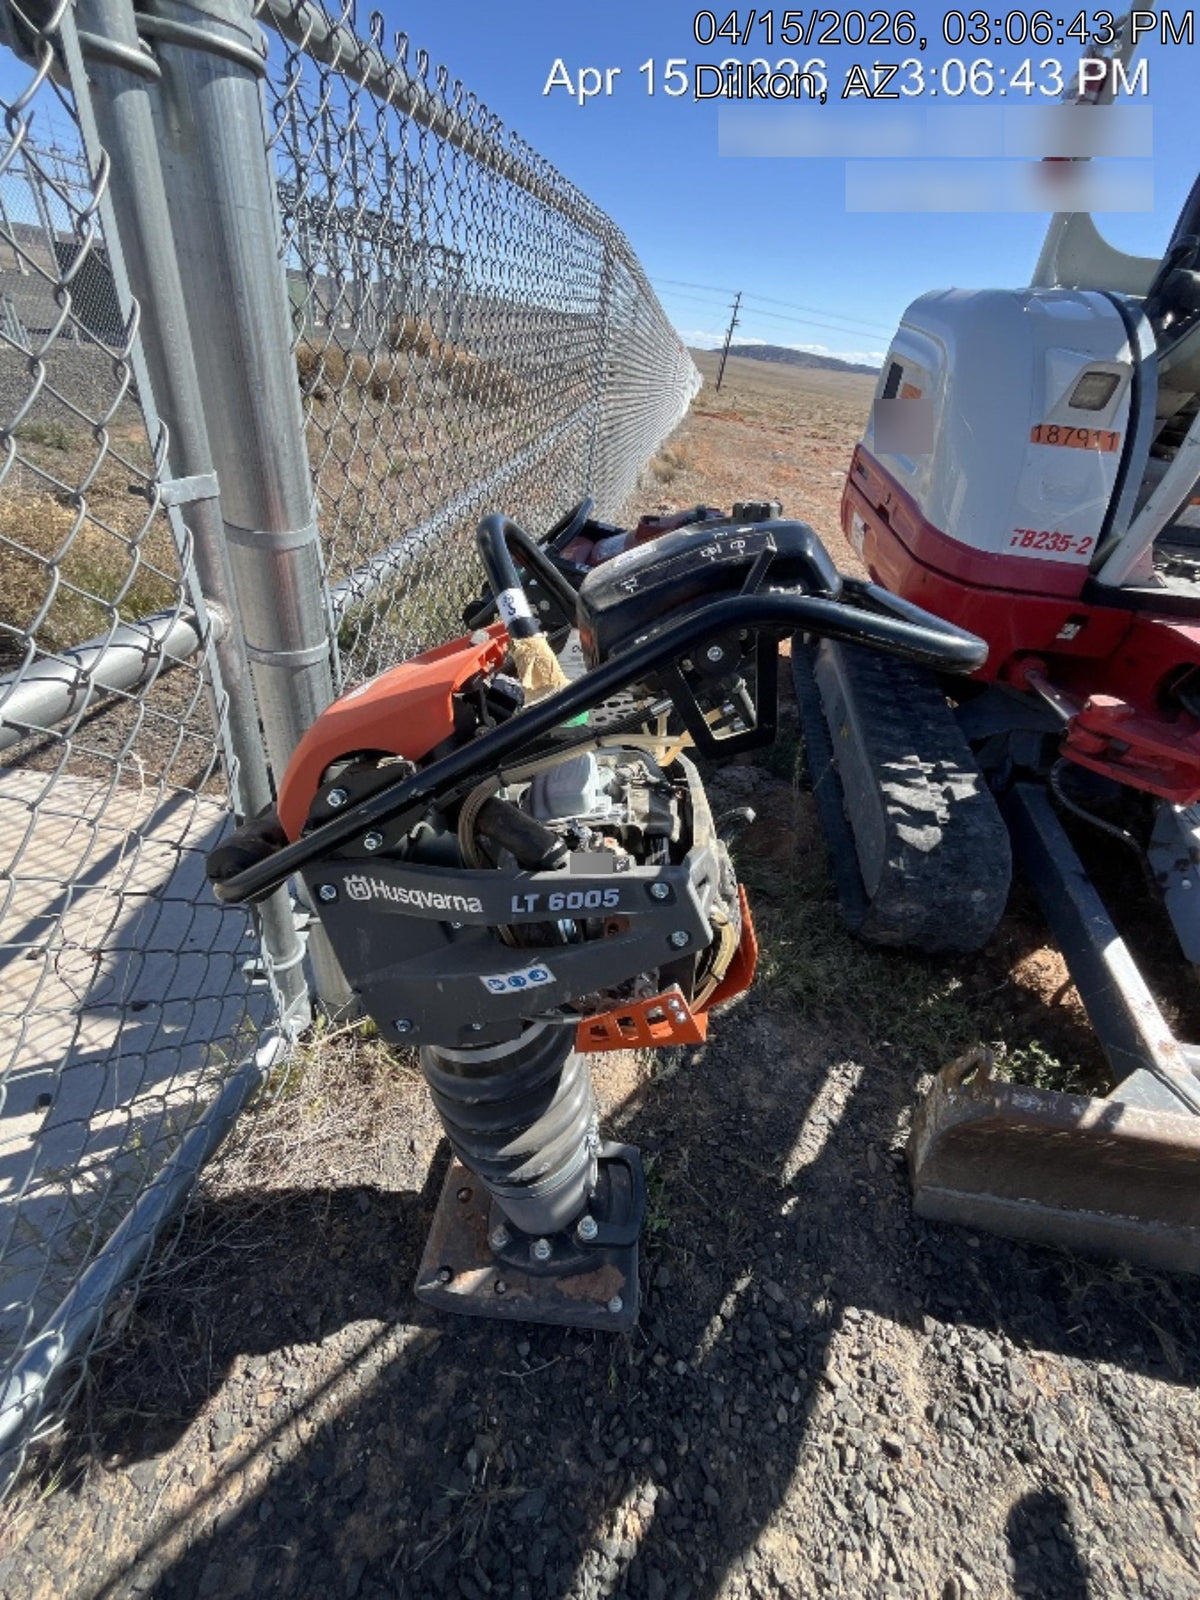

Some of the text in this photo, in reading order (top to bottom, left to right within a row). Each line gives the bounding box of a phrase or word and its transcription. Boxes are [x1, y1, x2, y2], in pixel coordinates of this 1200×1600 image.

[1032, 423, 1118, 451] 187911
[1009, 528, 1094, 555] TB235-2
[370, 877, 484, 913] Husqvarna
[511, 888, 620, 913] LT 6005
